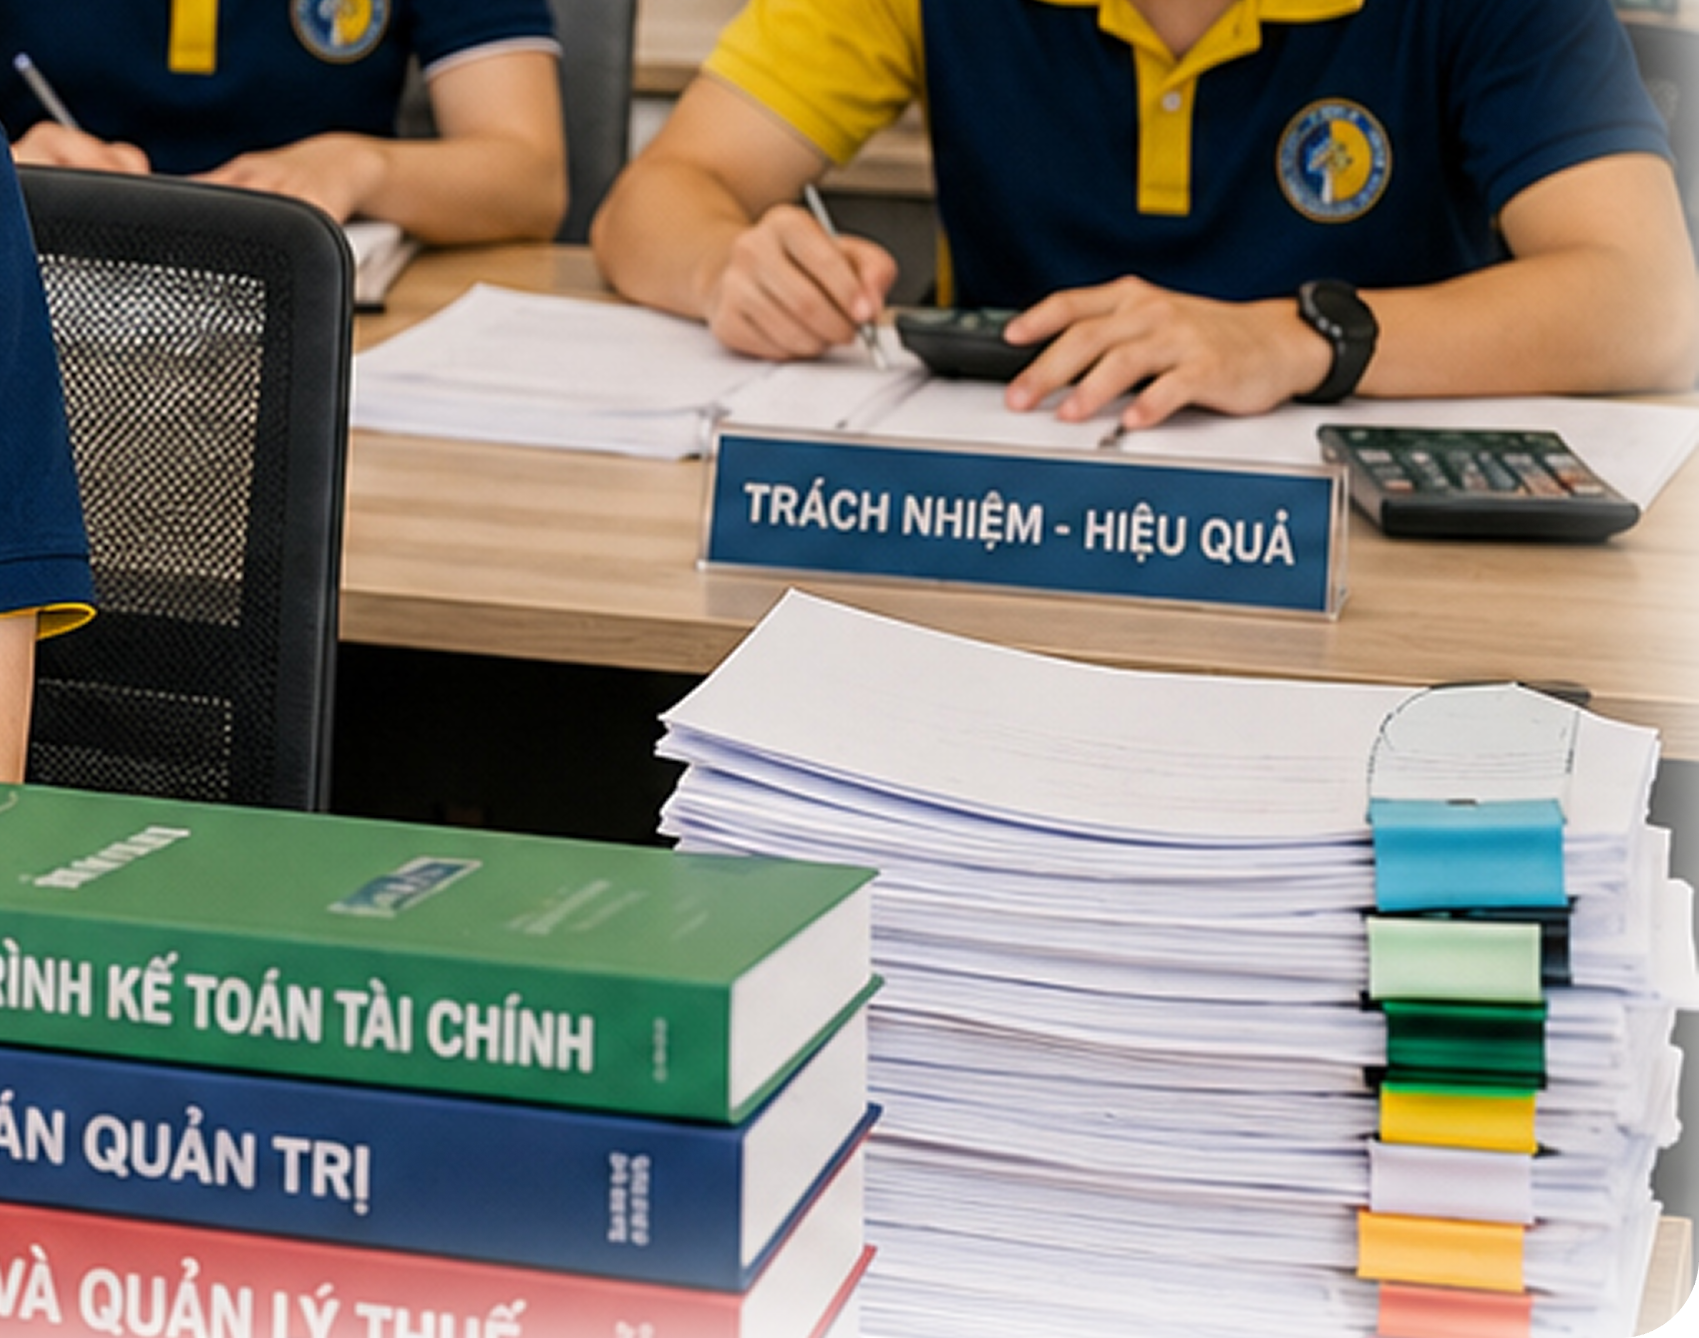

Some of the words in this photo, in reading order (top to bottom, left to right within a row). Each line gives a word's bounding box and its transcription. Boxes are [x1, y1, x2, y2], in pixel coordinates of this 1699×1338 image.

[743, 477, 891, 533] TRÁCH
[902, 491, 1044, 550] NHIỆM
[1085, 501, 1187, 562] HIỆU
[1201, 509, 1295, 565] QUẢ
[107, 950, 179, 1026] KẾ
[184, 967, 323, 1044] TOÁN
[333, 977, 413, 1054] TÀI
[426, 991, 595, 1074] CHÍNH
[83, 1105, 257, 1190] QUẢN
[270, 1135, 371, 1216] TRỊ
[78, 1256, 254, 1338] QUẢN
